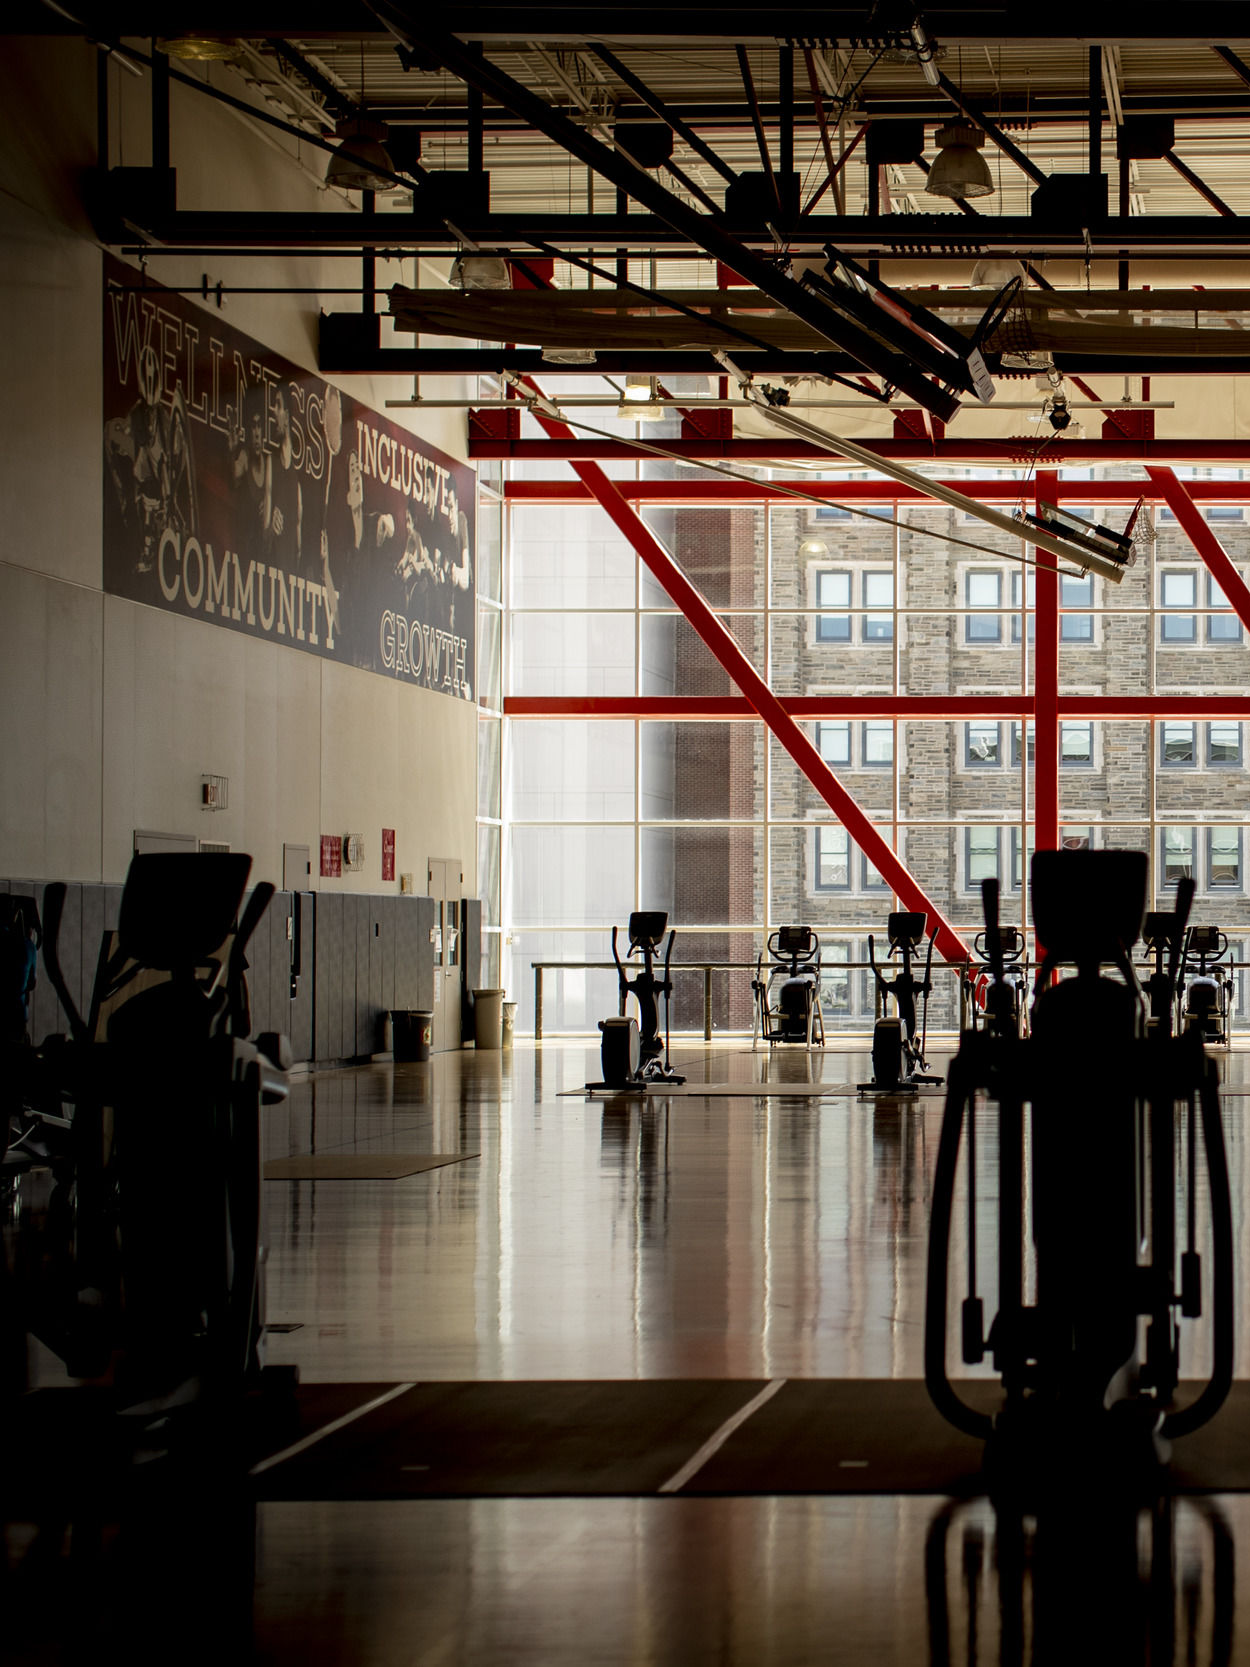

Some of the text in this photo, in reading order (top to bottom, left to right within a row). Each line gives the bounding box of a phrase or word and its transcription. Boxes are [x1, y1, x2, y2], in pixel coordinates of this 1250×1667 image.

[107, 278, 324, 480] WELLNESS
[356, 419, 450, 516] INCLUSIVE
[157, 527, 340, 650] COMMUNITY
[380, 609, 468, 690] GROWTH
